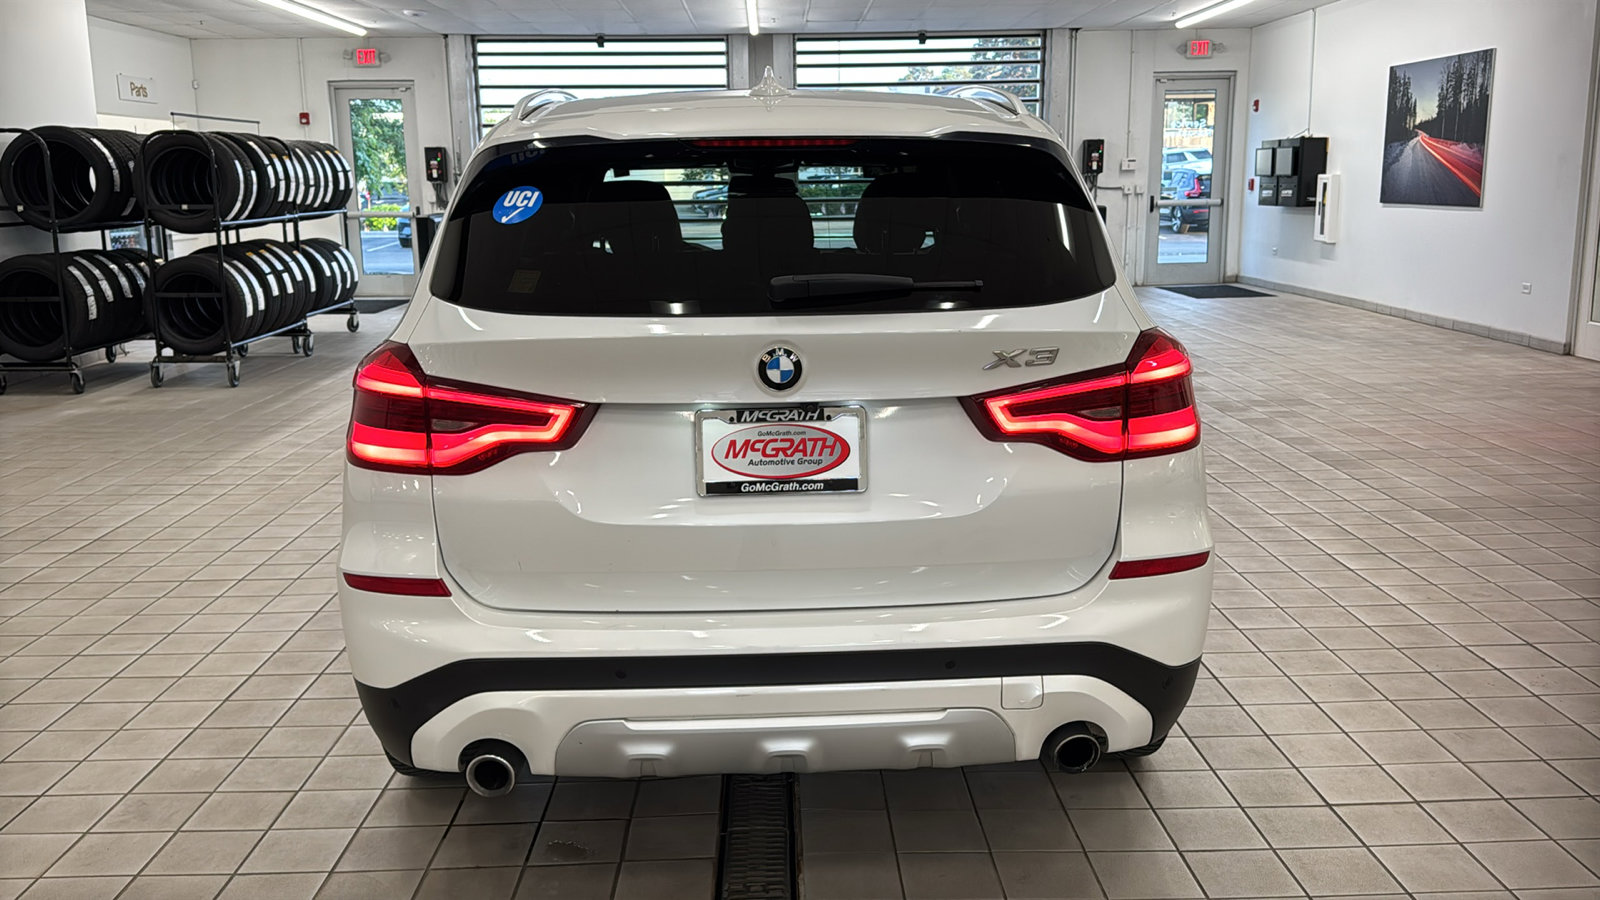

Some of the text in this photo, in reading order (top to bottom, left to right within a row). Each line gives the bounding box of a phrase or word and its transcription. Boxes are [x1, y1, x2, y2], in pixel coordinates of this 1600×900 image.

[1191, 40, 1209, 55] EXIT
[356, 48, 375, 64] EXIT
[130, 81, 148, 98] Parts
[503, 190, 540, 207] UCI
[762, 348, 798, 363] BMW
[982, 346, 1060, 371] X3
[747, 457, 823, 467] Automotive Group
[740, 482, 824, 493] GoMcGrath.com
